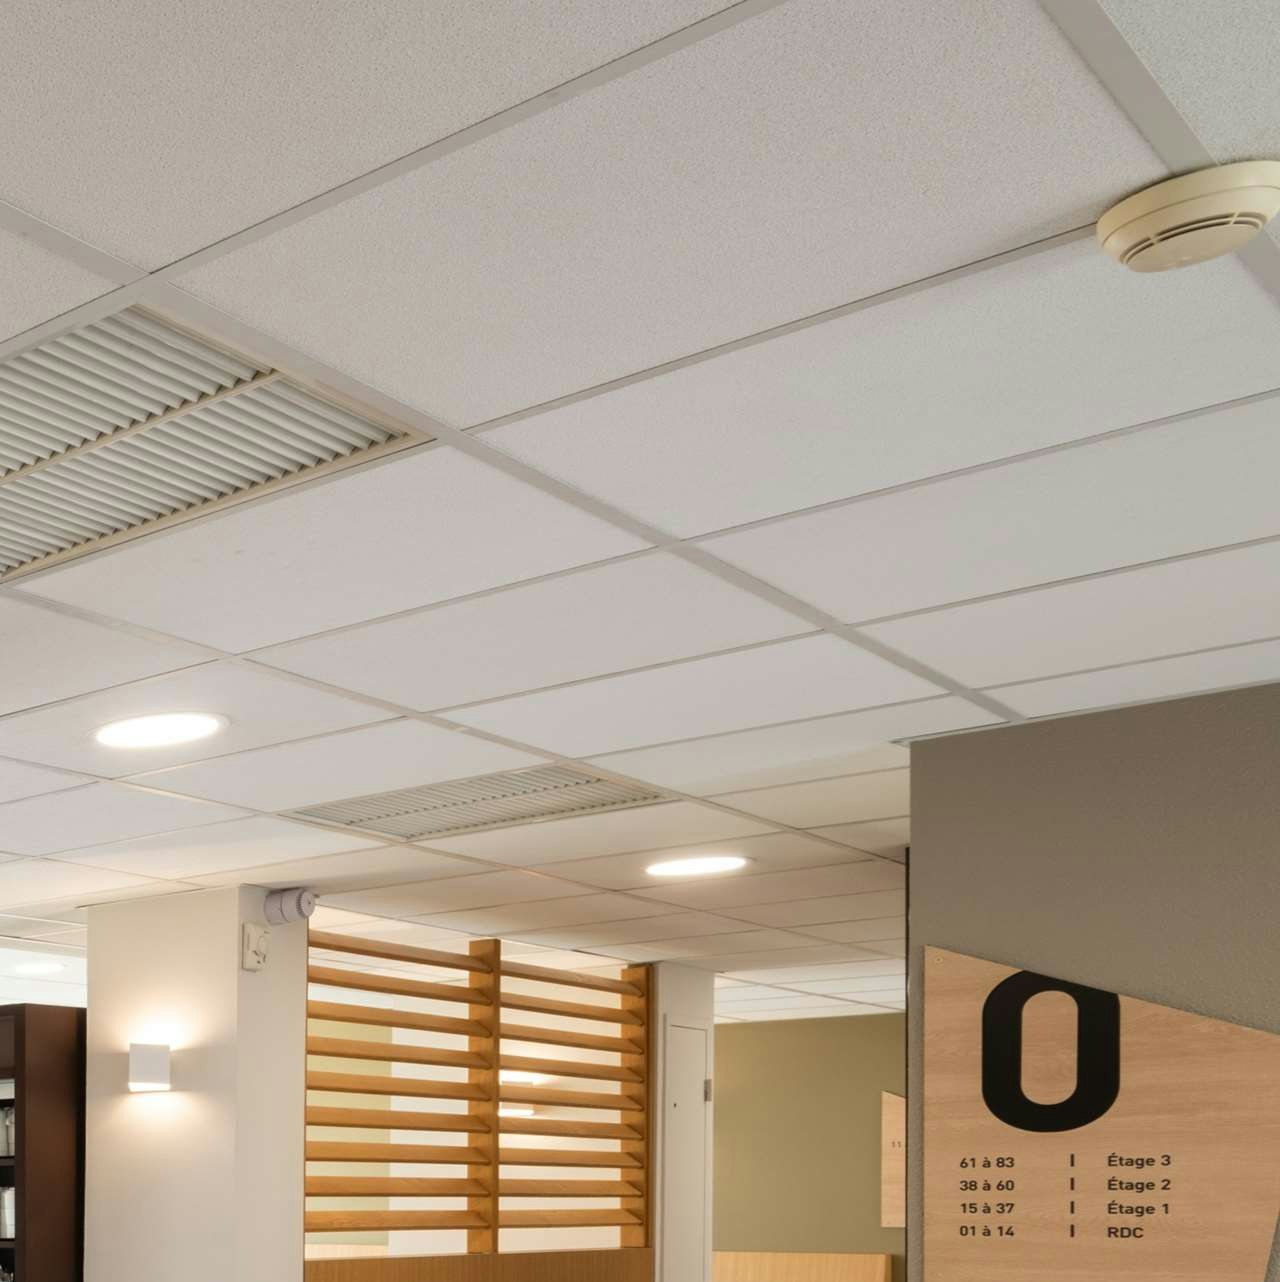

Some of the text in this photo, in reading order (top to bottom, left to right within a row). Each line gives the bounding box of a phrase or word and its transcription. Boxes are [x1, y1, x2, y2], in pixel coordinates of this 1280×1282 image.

[960, 1155, 1015, 1169] 61 à 83
[1107, 1153, 1171, 1169] Étage 3
[960, 1178, 1015, 1192] 38 à 60
[1107, 1177, 1171, 1193] Étage 2
[960, 1201, 1015, 1215] 15 à 37
[1107, 1201, 1169, 1217] Étage 1
[960, 1224, 1014, 1237] 01 à 14
[1107, 1227, 1144, 1239] RDC
